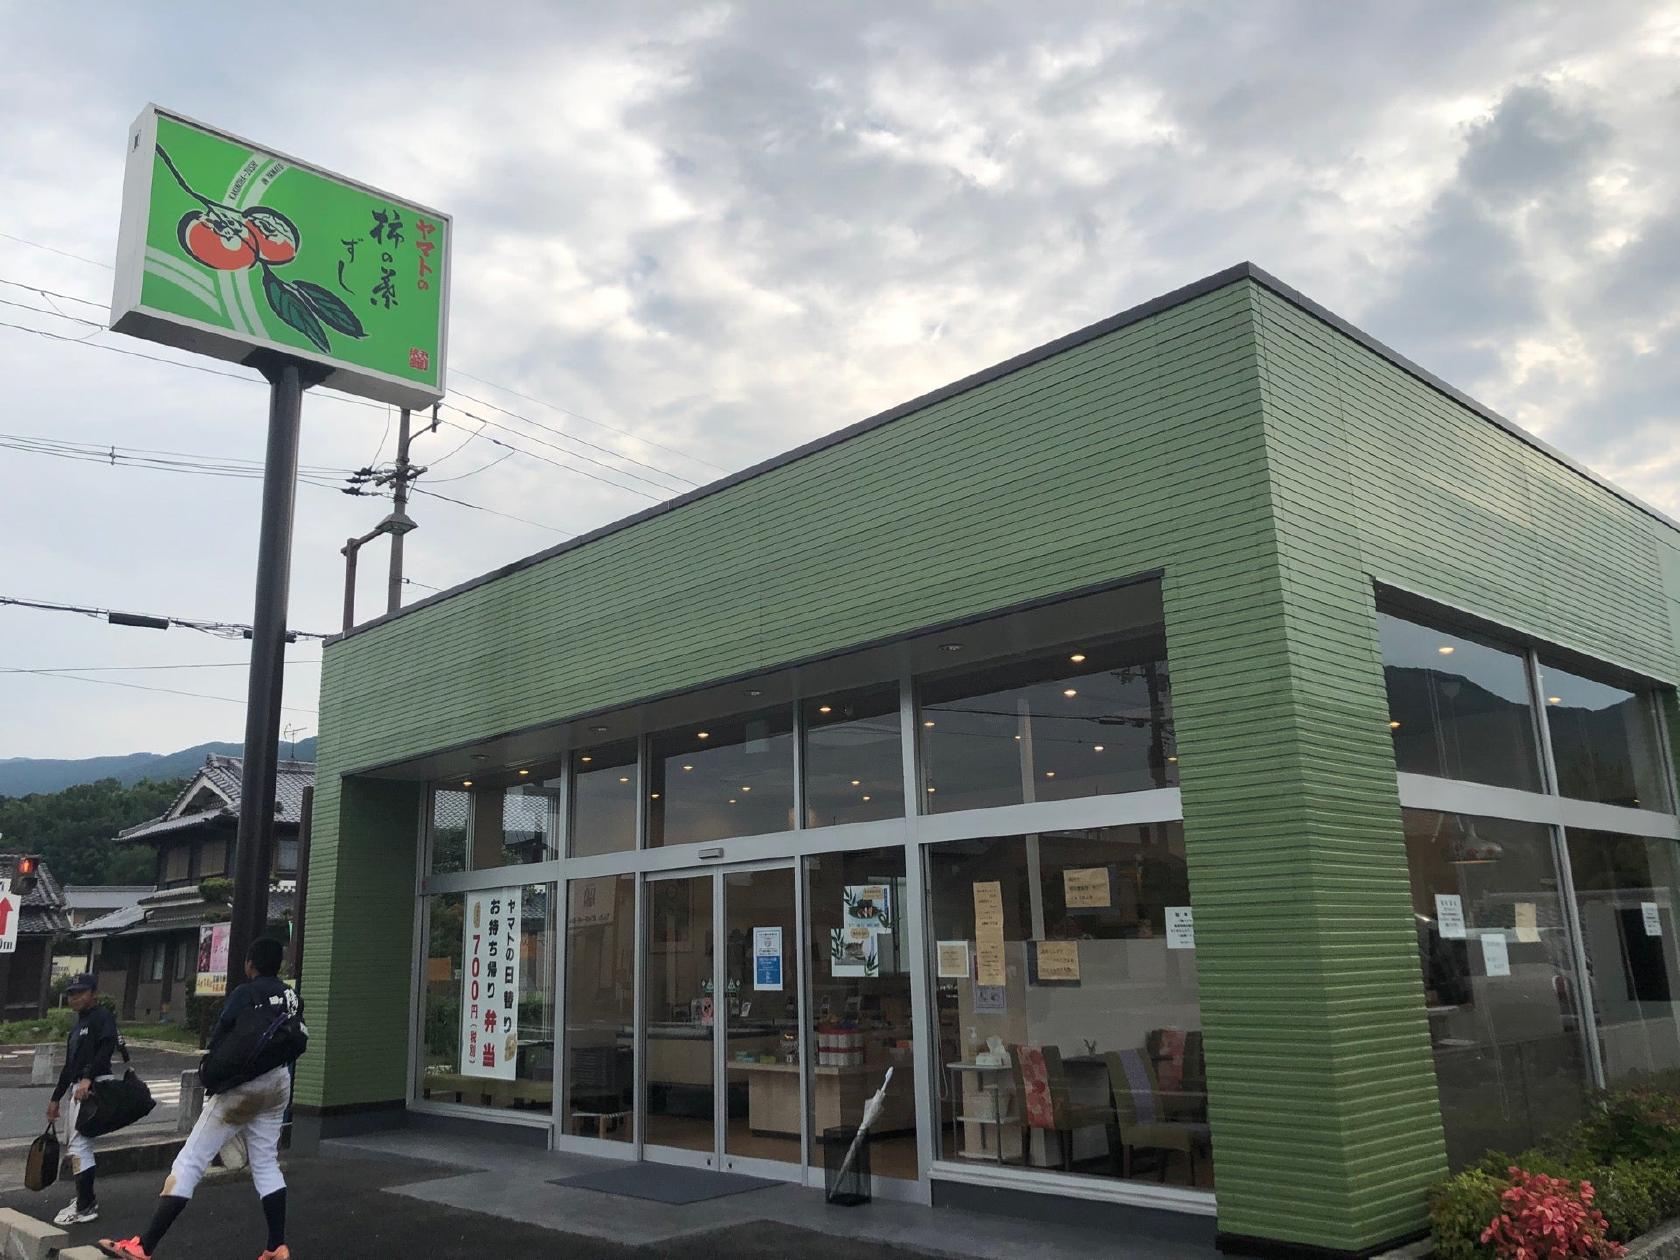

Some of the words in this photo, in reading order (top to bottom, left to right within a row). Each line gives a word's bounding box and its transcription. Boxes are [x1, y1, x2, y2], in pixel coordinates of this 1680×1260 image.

[338, 238, 363, 295] ずし
[416, 219, 436, 291] ヤマトの
[487, 899, 501, 999] お持ち帰り
[503, 899, 516, 1034] ヤマトの日替り
[482, 1008, 497, 1068] 弁当
